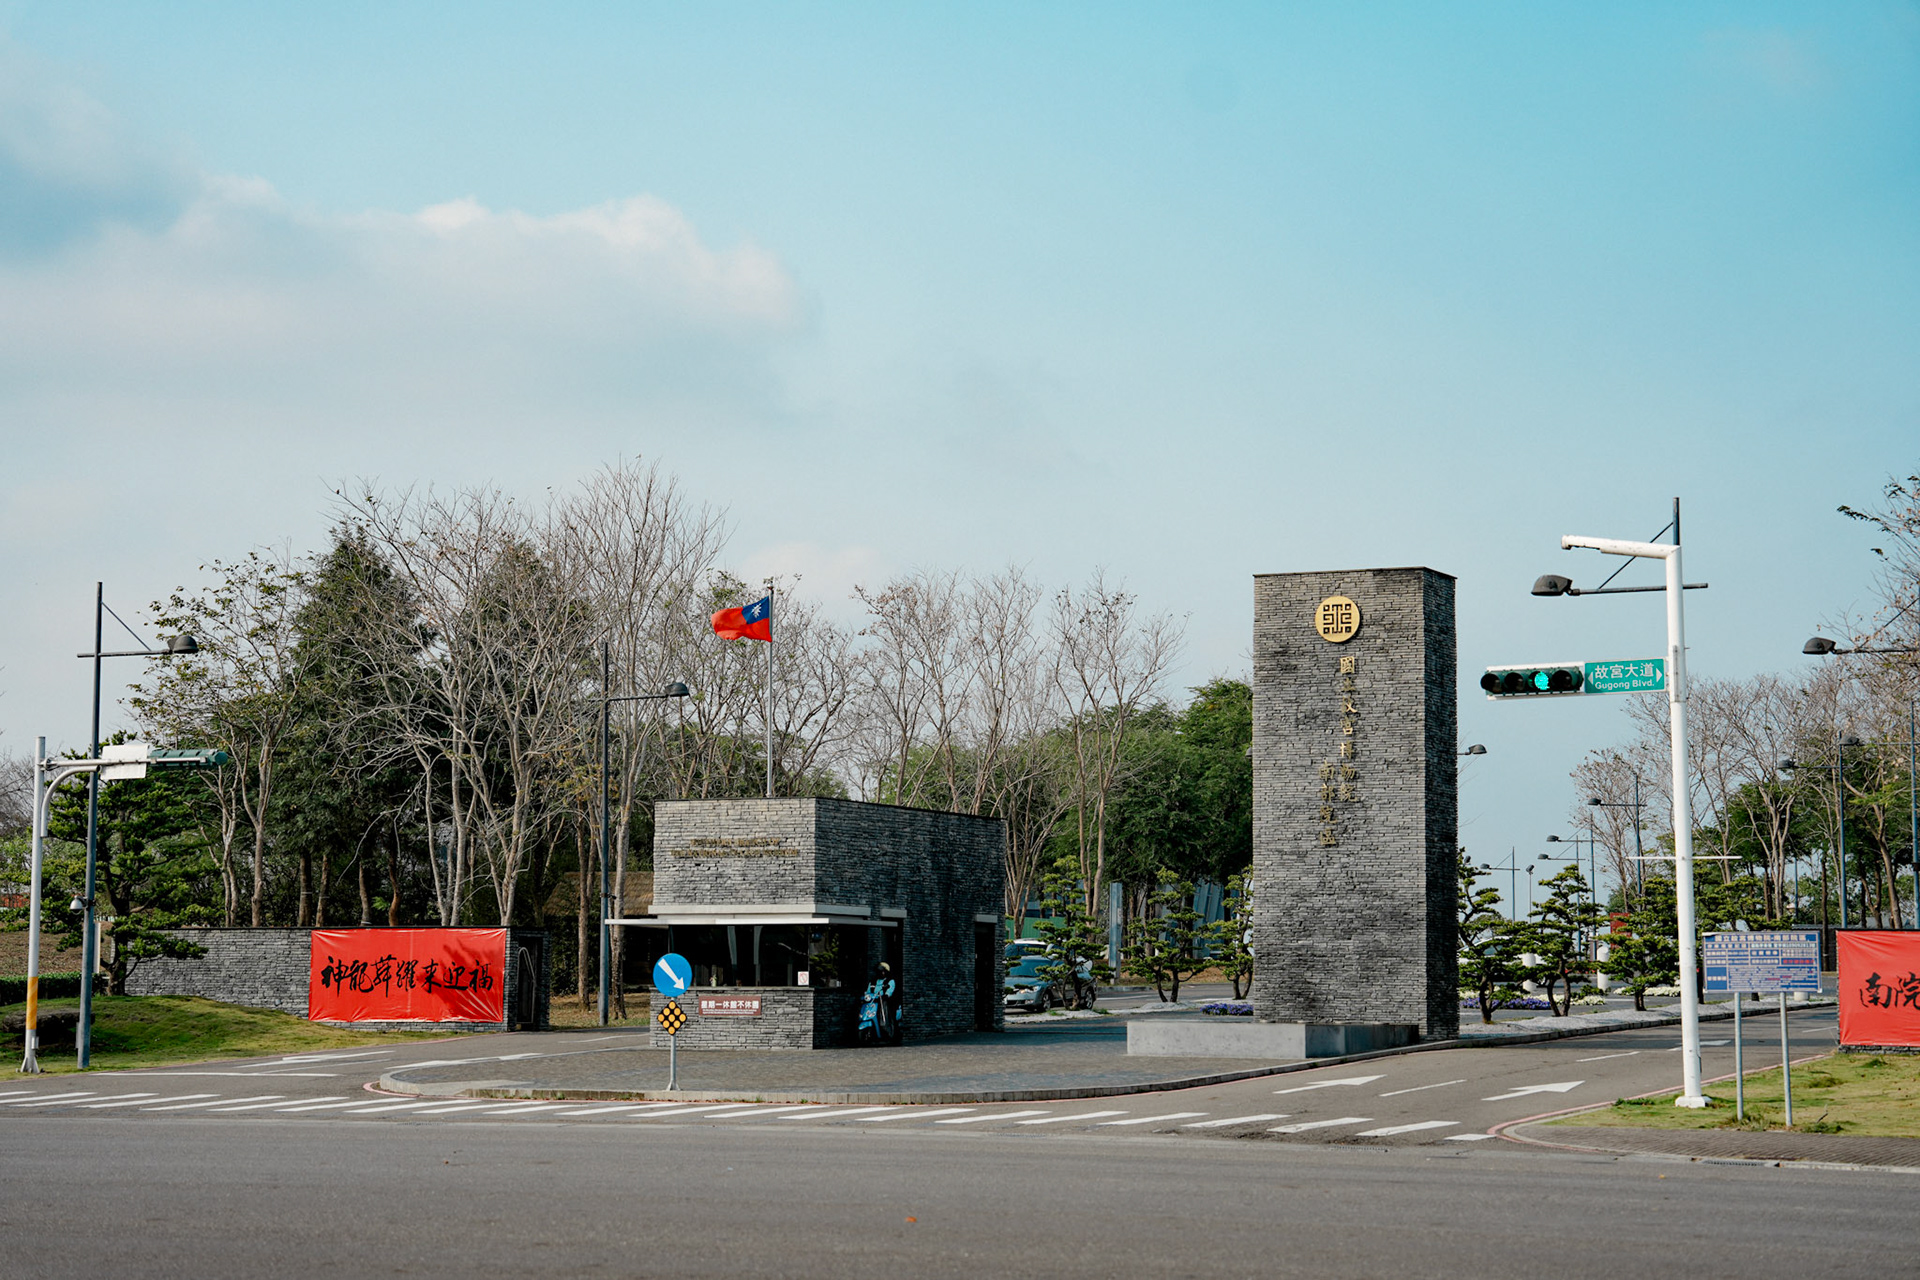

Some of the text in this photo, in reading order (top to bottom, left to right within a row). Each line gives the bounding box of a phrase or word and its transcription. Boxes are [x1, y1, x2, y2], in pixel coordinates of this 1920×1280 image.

[1595, 662, 1654, 679] 故宮大道
[1595, 679, 1654, 690] Gugong Blvd.
[1319, 760, 1336, 845] 南部院區
